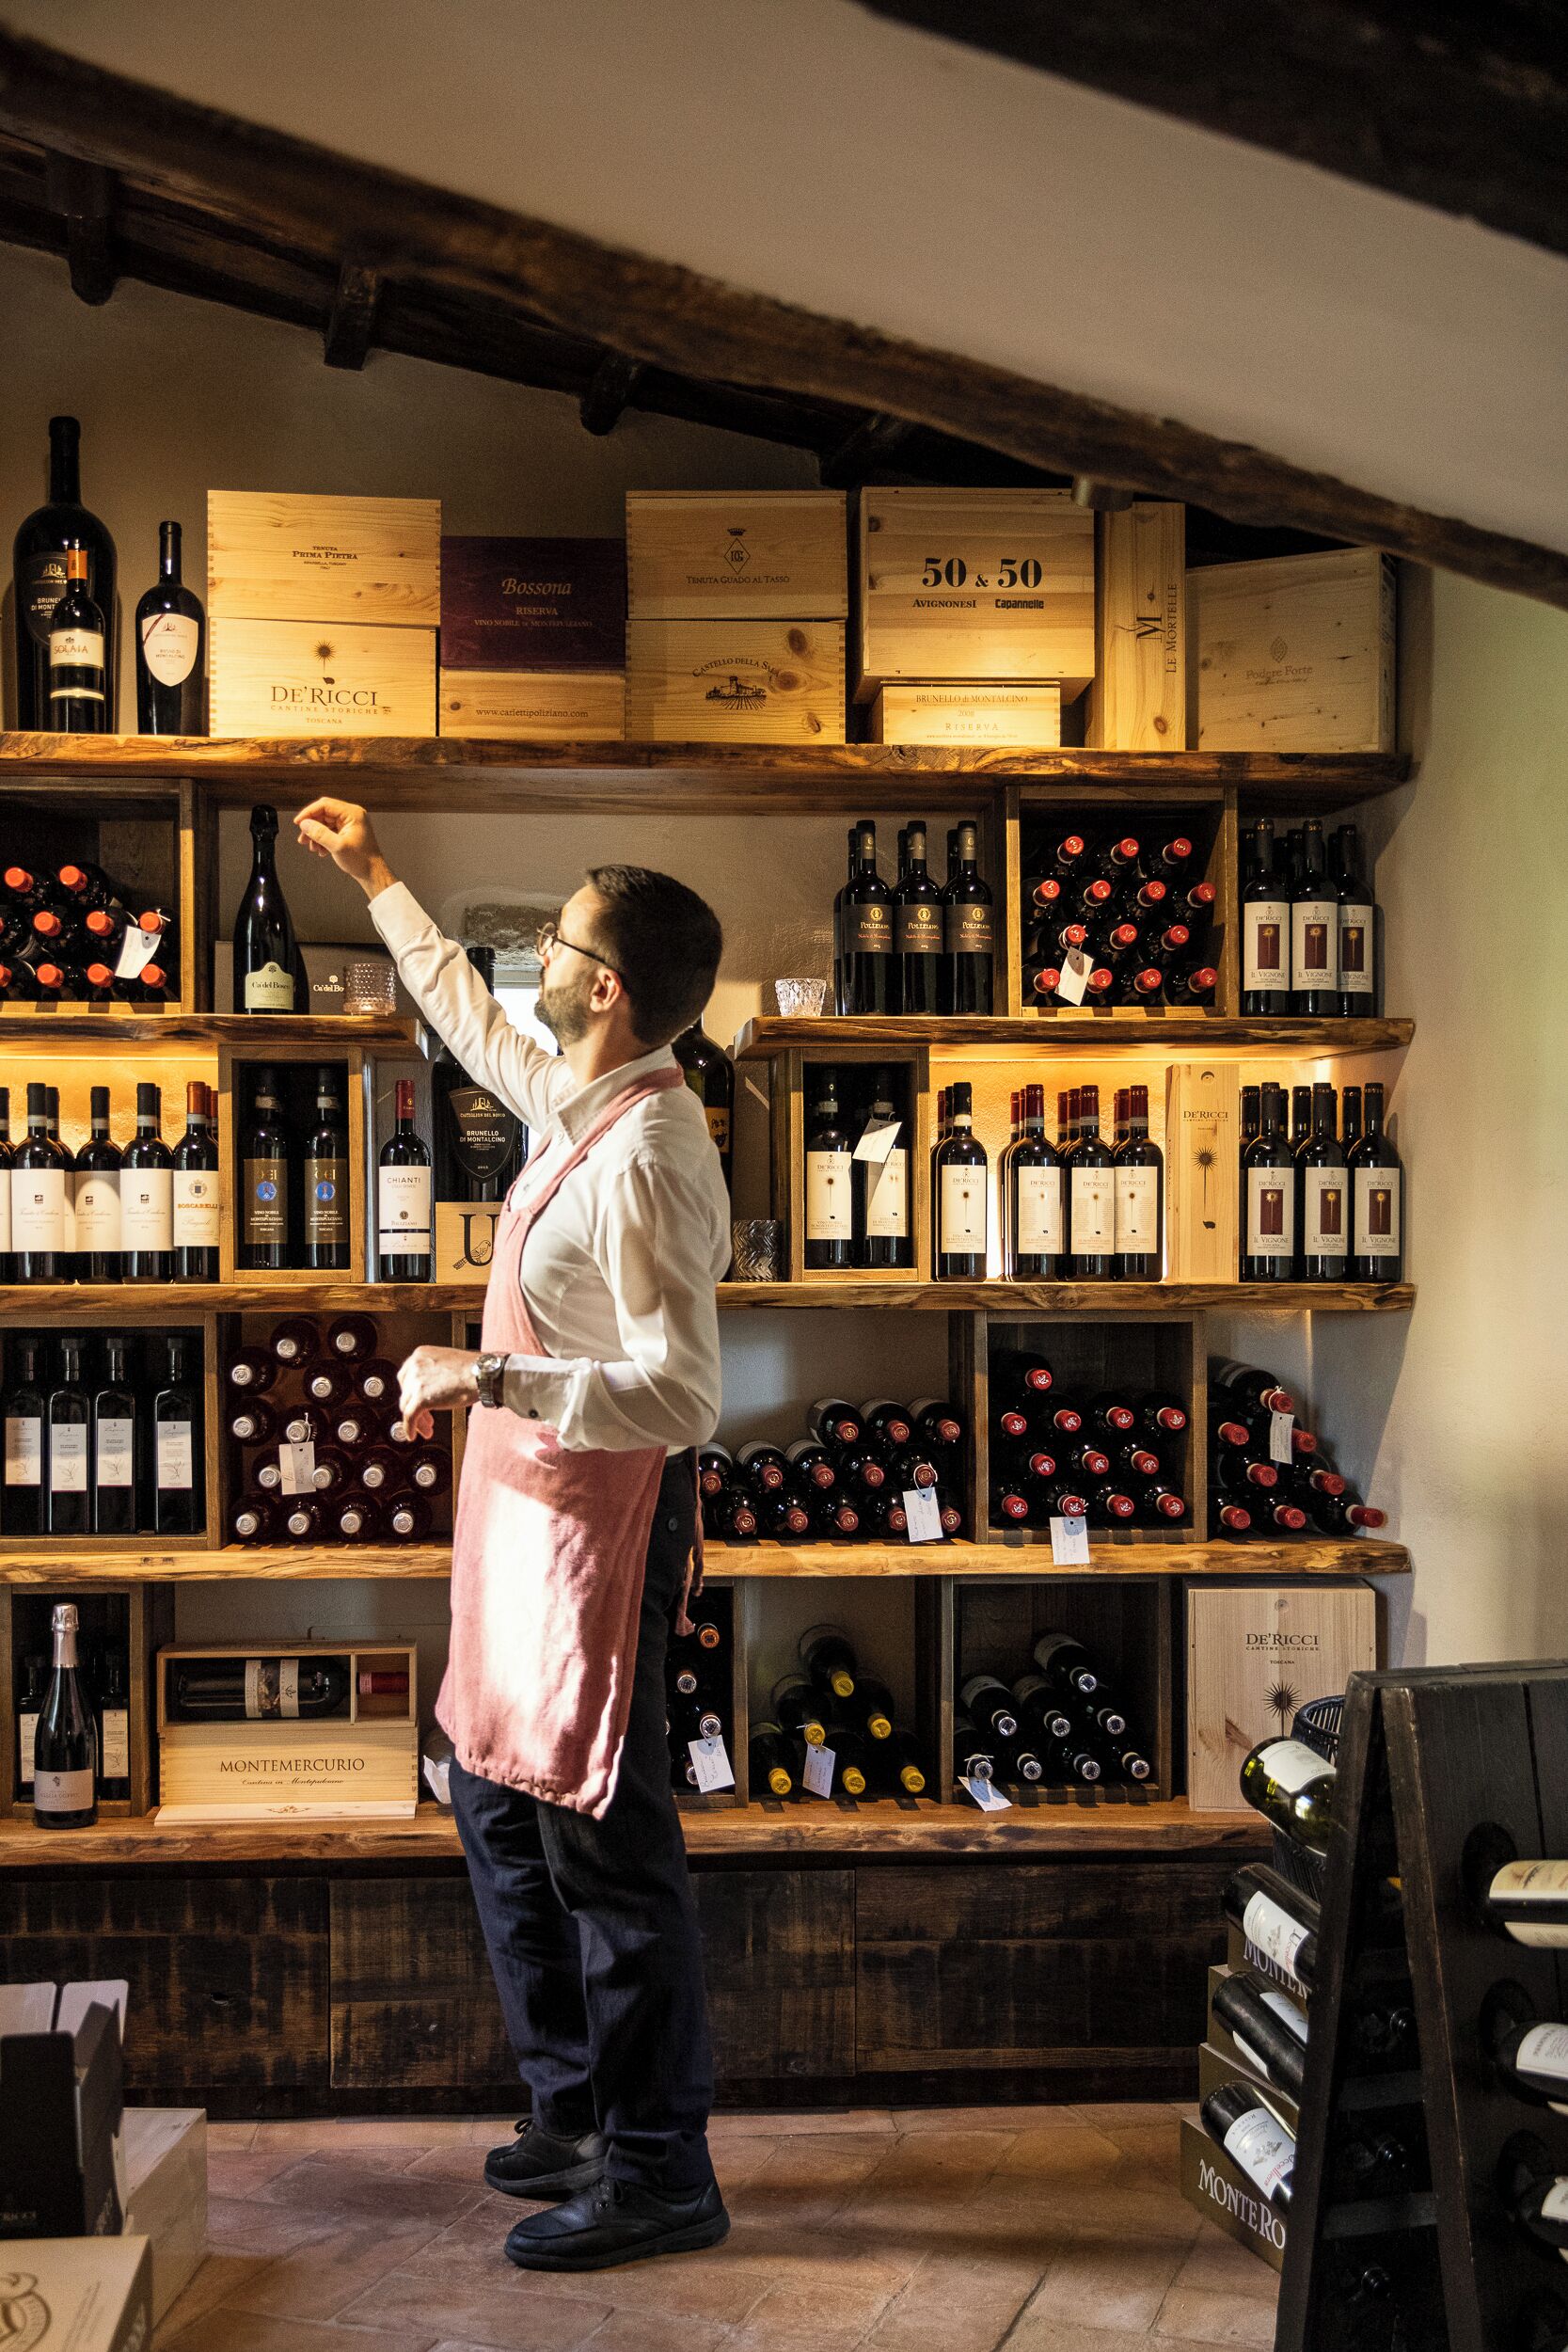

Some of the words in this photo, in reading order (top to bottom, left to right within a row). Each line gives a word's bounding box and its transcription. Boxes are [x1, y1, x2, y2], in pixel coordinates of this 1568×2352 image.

[292, 550, 322, 559] PRIMA
[325, 551, 357, 560] PIETRA
[921, 557, 967, 589] 50
[974, 573, 989, 589] &
[998, 558, 1042, 589] 50
[686, 576, 719, 584] TENUTA
[721, 576, 751, 584] GUADO
[764, 575, 790, 583] TASSO
[501, 578, 573, 596] Bossona
[912, 598, 977, 609] AVIGNONESI
[994, 598, 1044, 610] Capannelle
[516, 607, 559, 615] RISERVA
[1165, 584, 1177, 655] MORTELLE
[54, 645, 88, 655] SOLAIA
[692, 658, 734, 677] CASTELLO
[735, 658, 759, 668] DELLA
[1165, 660, 1176, 674] LE
[1246, 667, 1284, 680] Podere
[1285, 665, 1313, 676] Forte
[271, 685, 378, 707] DE'RICCI
[916, 694, 961, 704] BRUNELLO
[971, 694, 1028, 703] MONTALCINO
[271, 705, 318, 713] CANTINE
[325, 707, 378, 715] STORICHE
[476, 708, 589, 719] www.carlettipoliziano.com
[945, 723, 999, 731] RISERVA
[1183, 1110, 1228, 1120] DE'RICCI
[459, 1214, 499, 1266] U
[1246, 1633, 1319, 1646] DE'RICCI
[220, 1757, 365, 1772] MONTEMERCURIO
